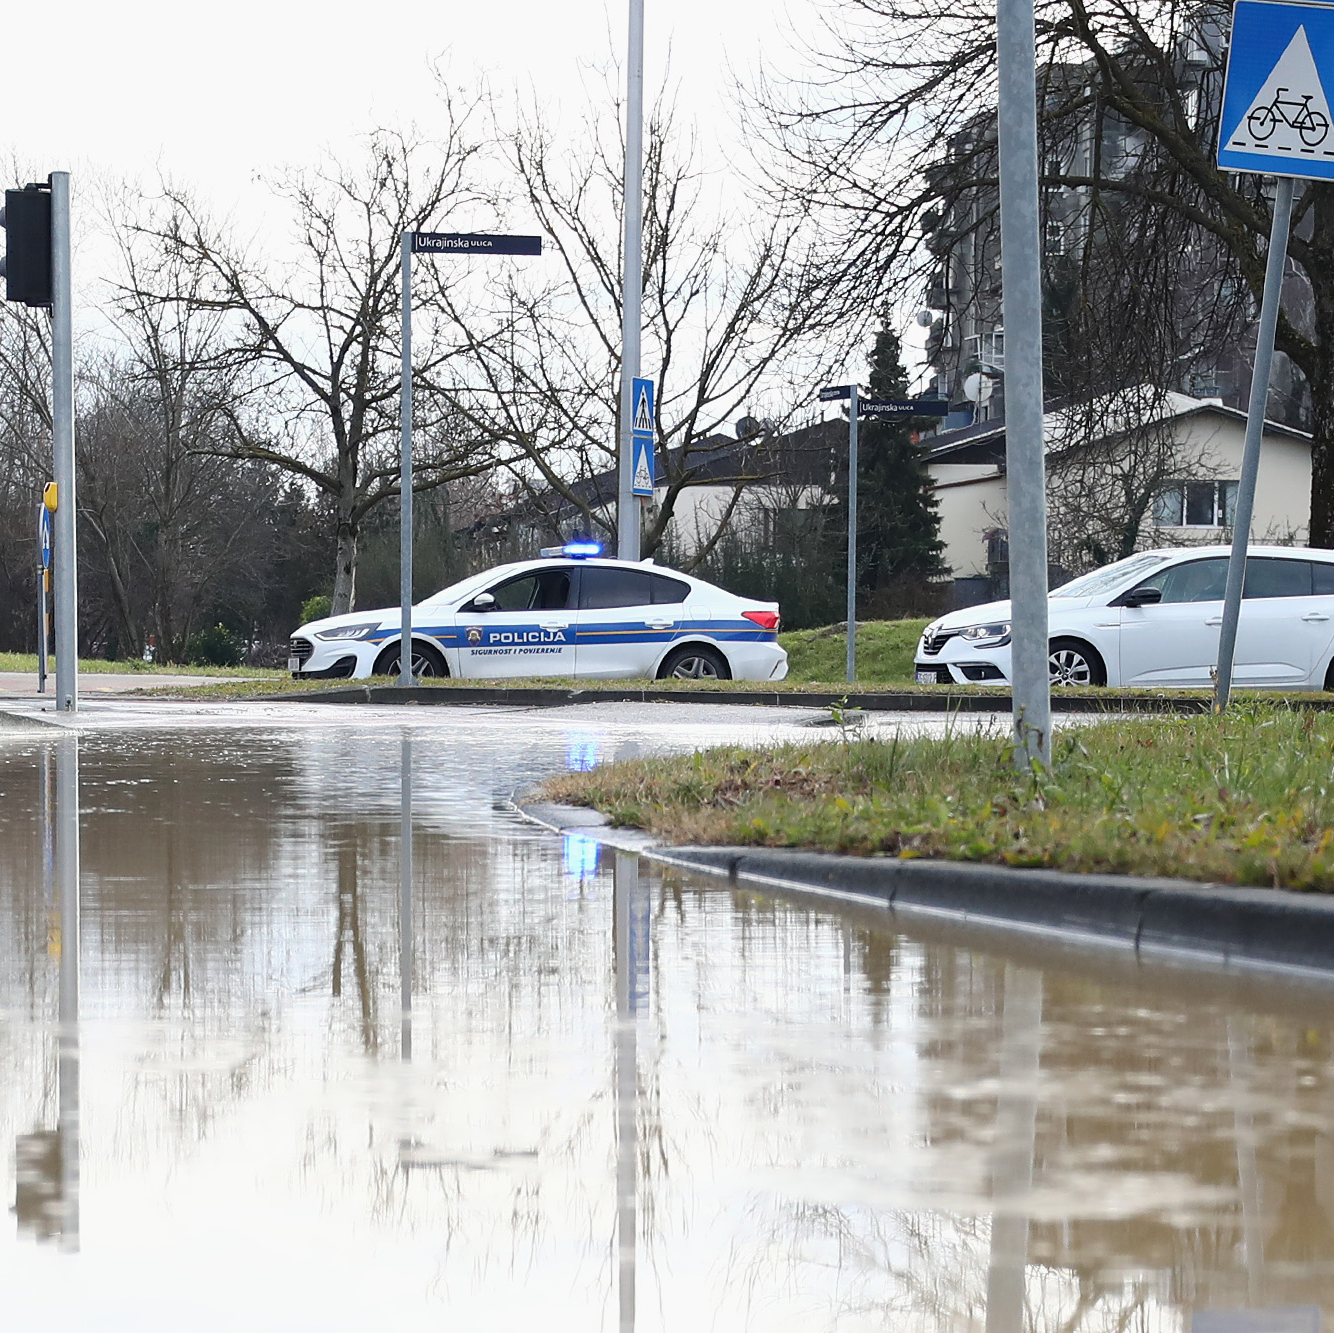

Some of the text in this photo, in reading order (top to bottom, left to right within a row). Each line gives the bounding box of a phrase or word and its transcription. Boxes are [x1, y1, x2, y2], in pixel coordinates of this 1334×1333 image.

[418, 237, 470, 250] Ukrajinska
[862, 403, 898, 414] Ukrajinska
[489, 631, 566, 643] POLICIJA
